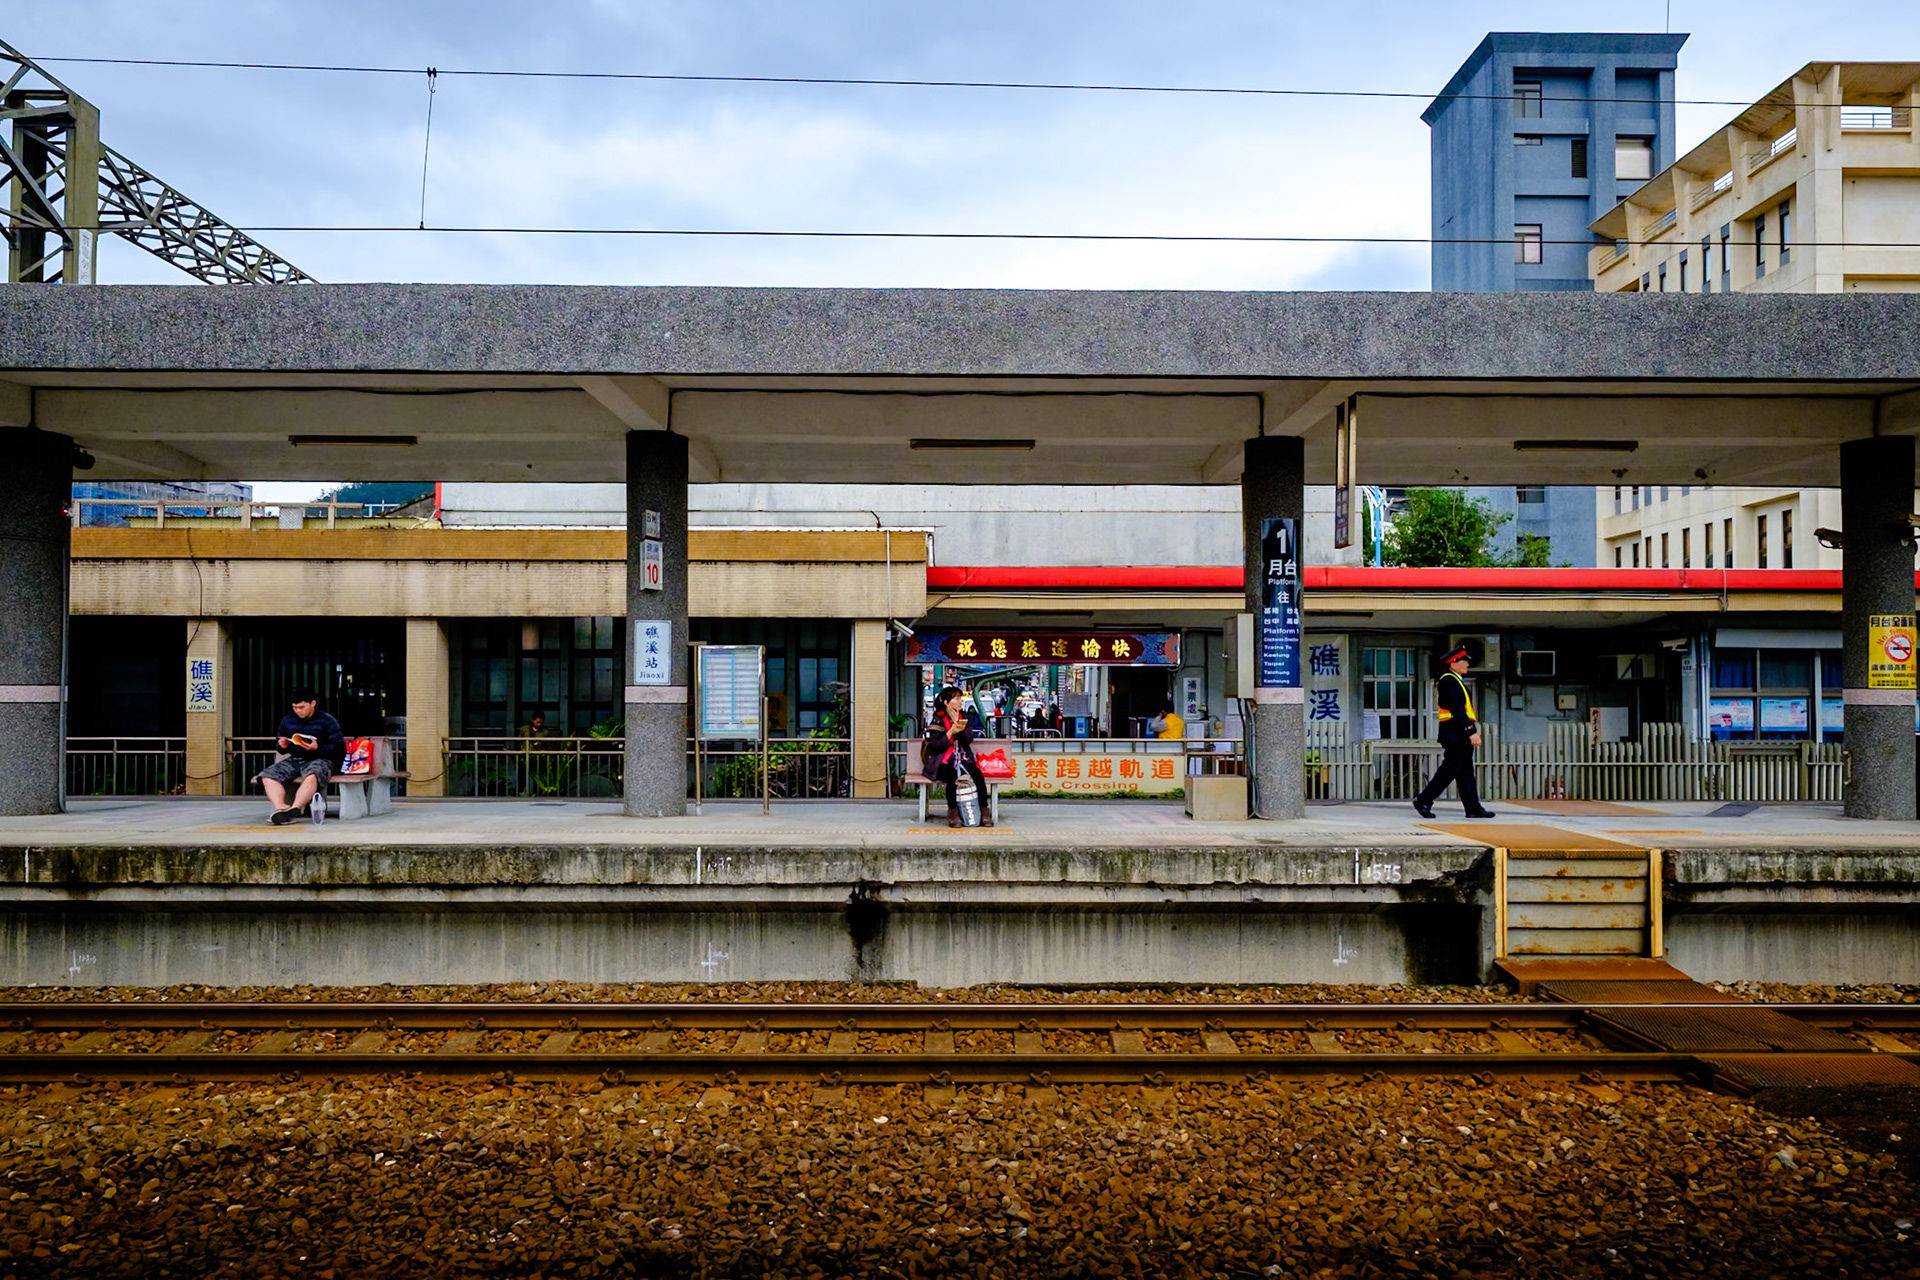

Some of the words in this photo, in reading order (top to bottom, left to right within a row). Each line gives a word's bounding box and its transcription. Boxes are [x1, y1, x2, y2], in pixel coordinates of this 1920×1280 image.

[1276, 528, 1287, 554] 1
[647, 563, 659, 584] 10
[1268, 559, 1297, 576] 月台
[1277, 591, 1289, 604] 往
[645, 626, 660, 669] 礁溪站
[956, 638, 1131, 659] 祝您旅途愉快
[190, 660, 213, 702] 礁溪
[640, 671, 665, 679] Jiaoxi
[1309, 644, 1341, 720] 礁溪
[1012, 758, 1175, 780] 禁跨越軌道
[1029, 781, 1052, 790] No
[1061, 780, 1139, 792] Crossing
[1366, 863, 1402, 882] 1575
